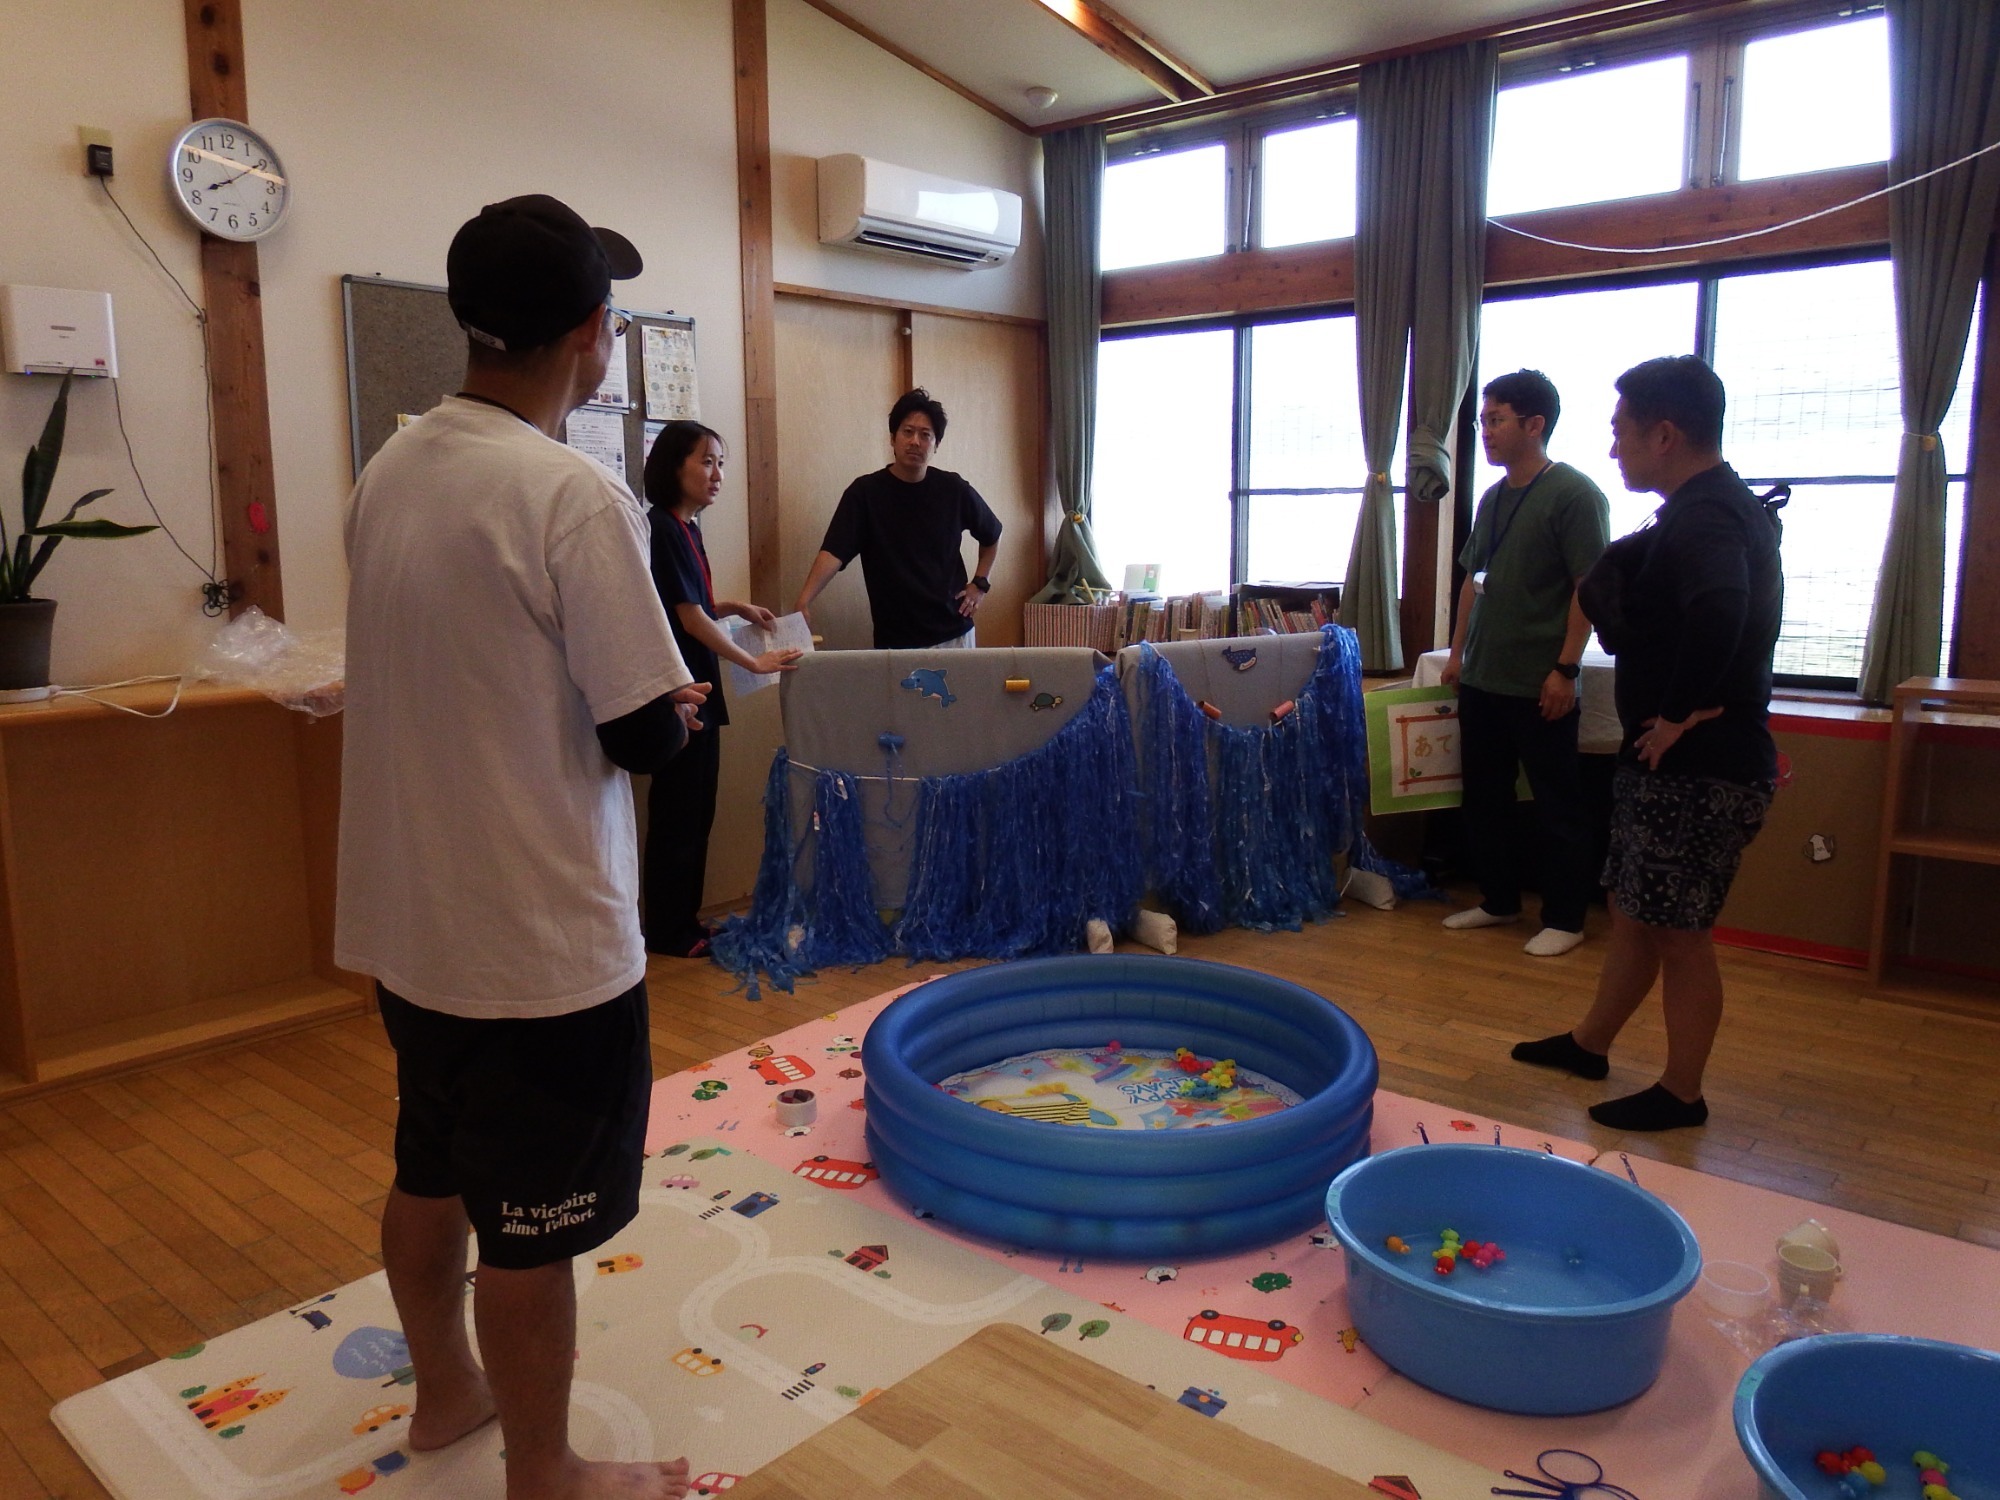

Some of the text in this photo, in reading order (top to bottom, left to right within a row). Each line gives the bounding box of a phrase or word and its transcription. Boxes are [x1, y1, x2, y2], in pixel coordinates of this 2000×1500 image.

[202, 136, 214, 151] 11
[221, 134, 235, 150] 12
[188, 150, 202, 164] 10
[245, 143, 250, 157] 1
[183, 168, 194, 183] 9
[266, 181, 276, 195] 3
[192, 190, 203, 205] 8
[210, 208, 219, 221] 7
[261, 202, 270, 214] 4
[228, 215, 239, 229] 6
[249, 213, 258, 227] 5
[502, 1202, 524, 1217] La
[502, 1219, 540, 1236] aime
